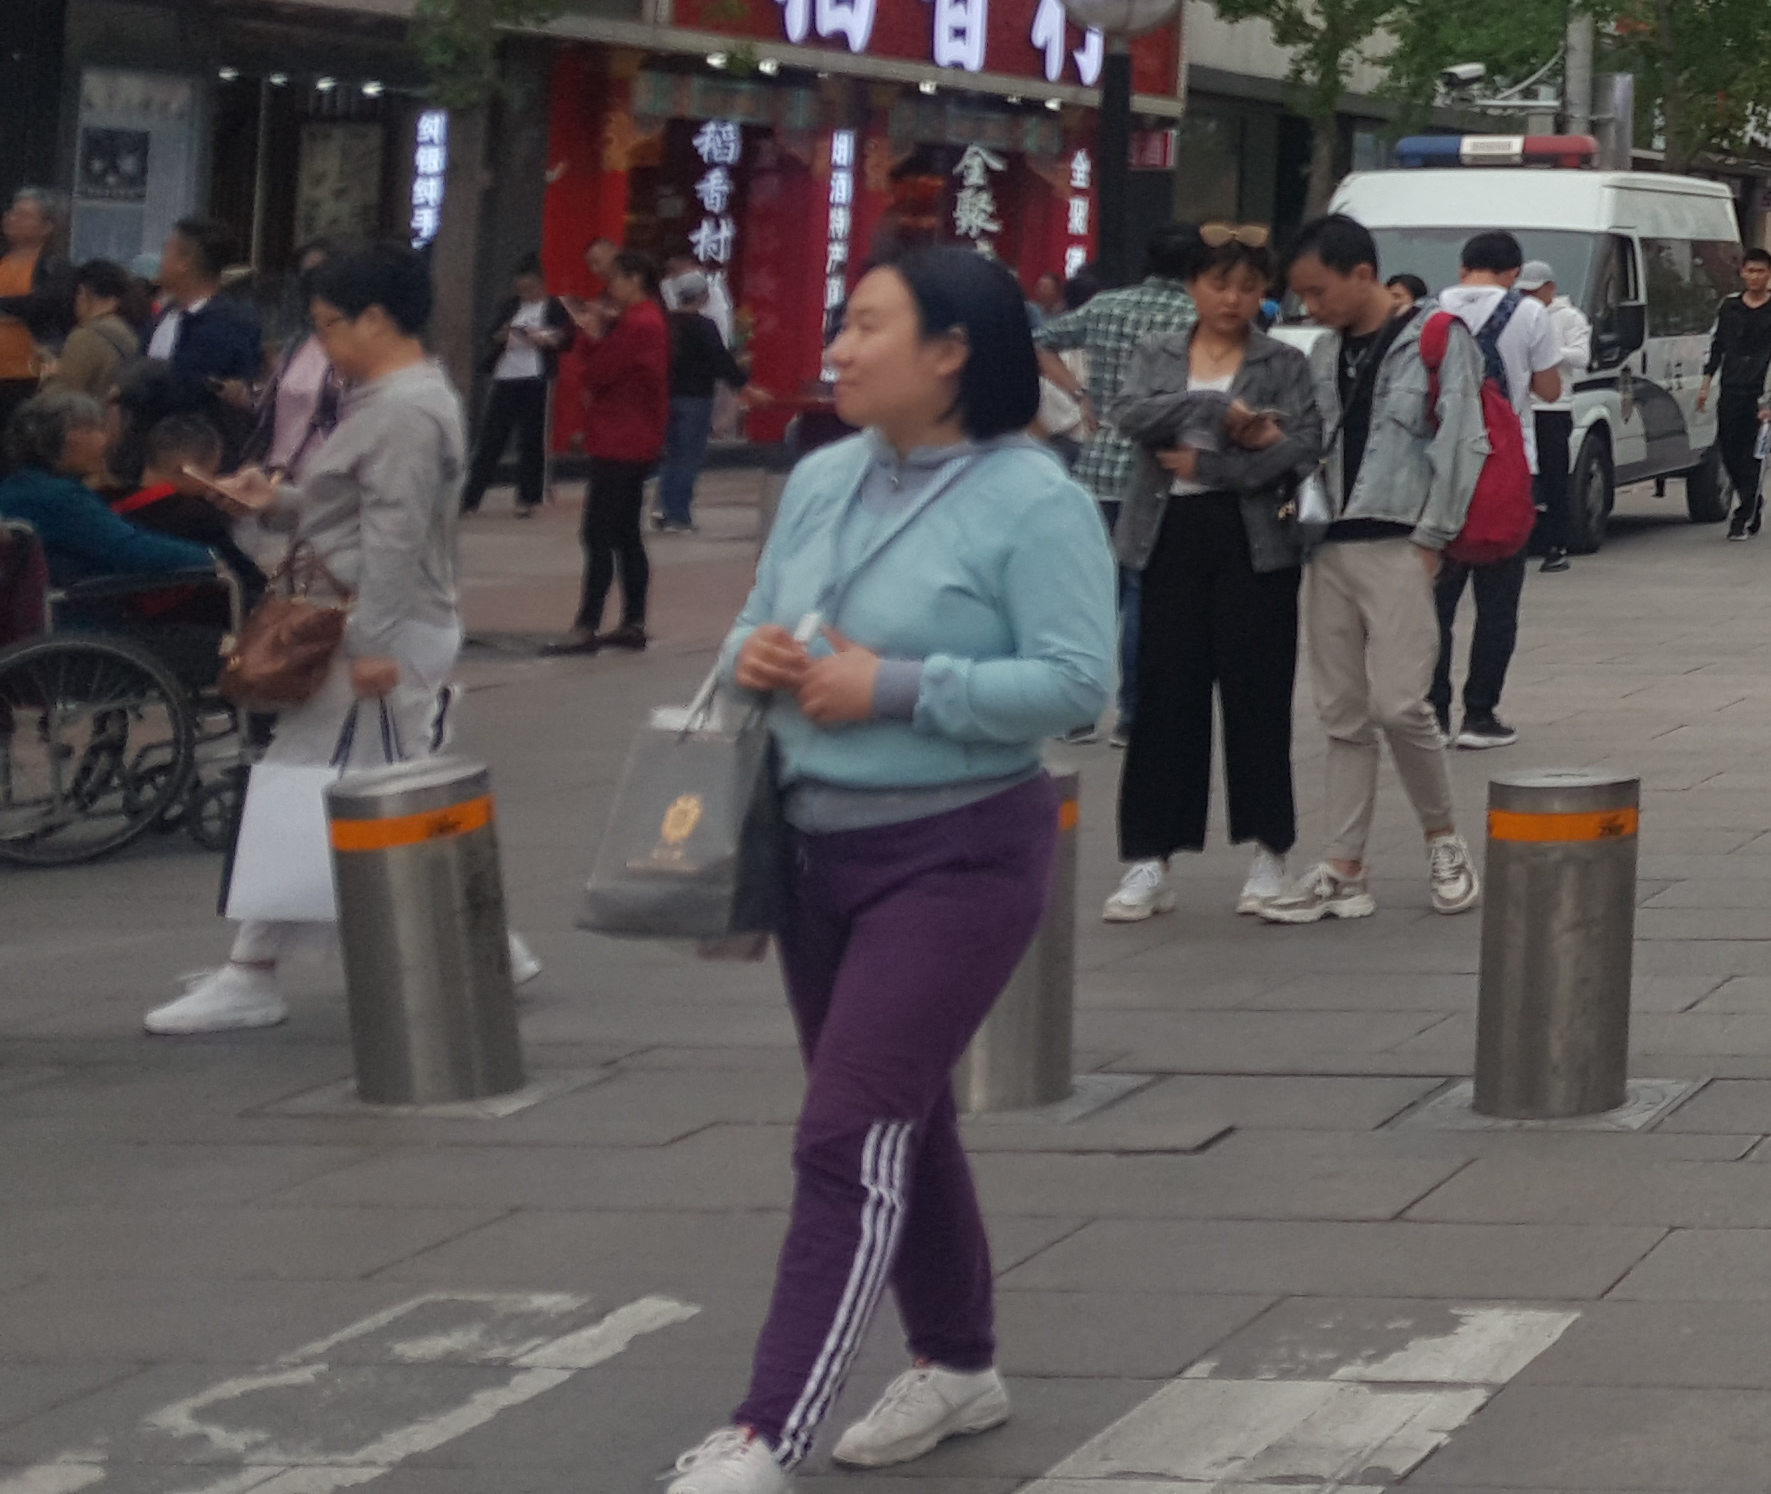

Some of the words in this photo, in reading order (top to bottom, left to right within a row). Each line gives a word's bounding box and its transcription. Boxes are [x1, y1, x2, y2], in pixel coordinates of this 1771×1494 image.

[691, 119, 742, 264] 稻香村
[952, 143, 1007, 261] 全聚
